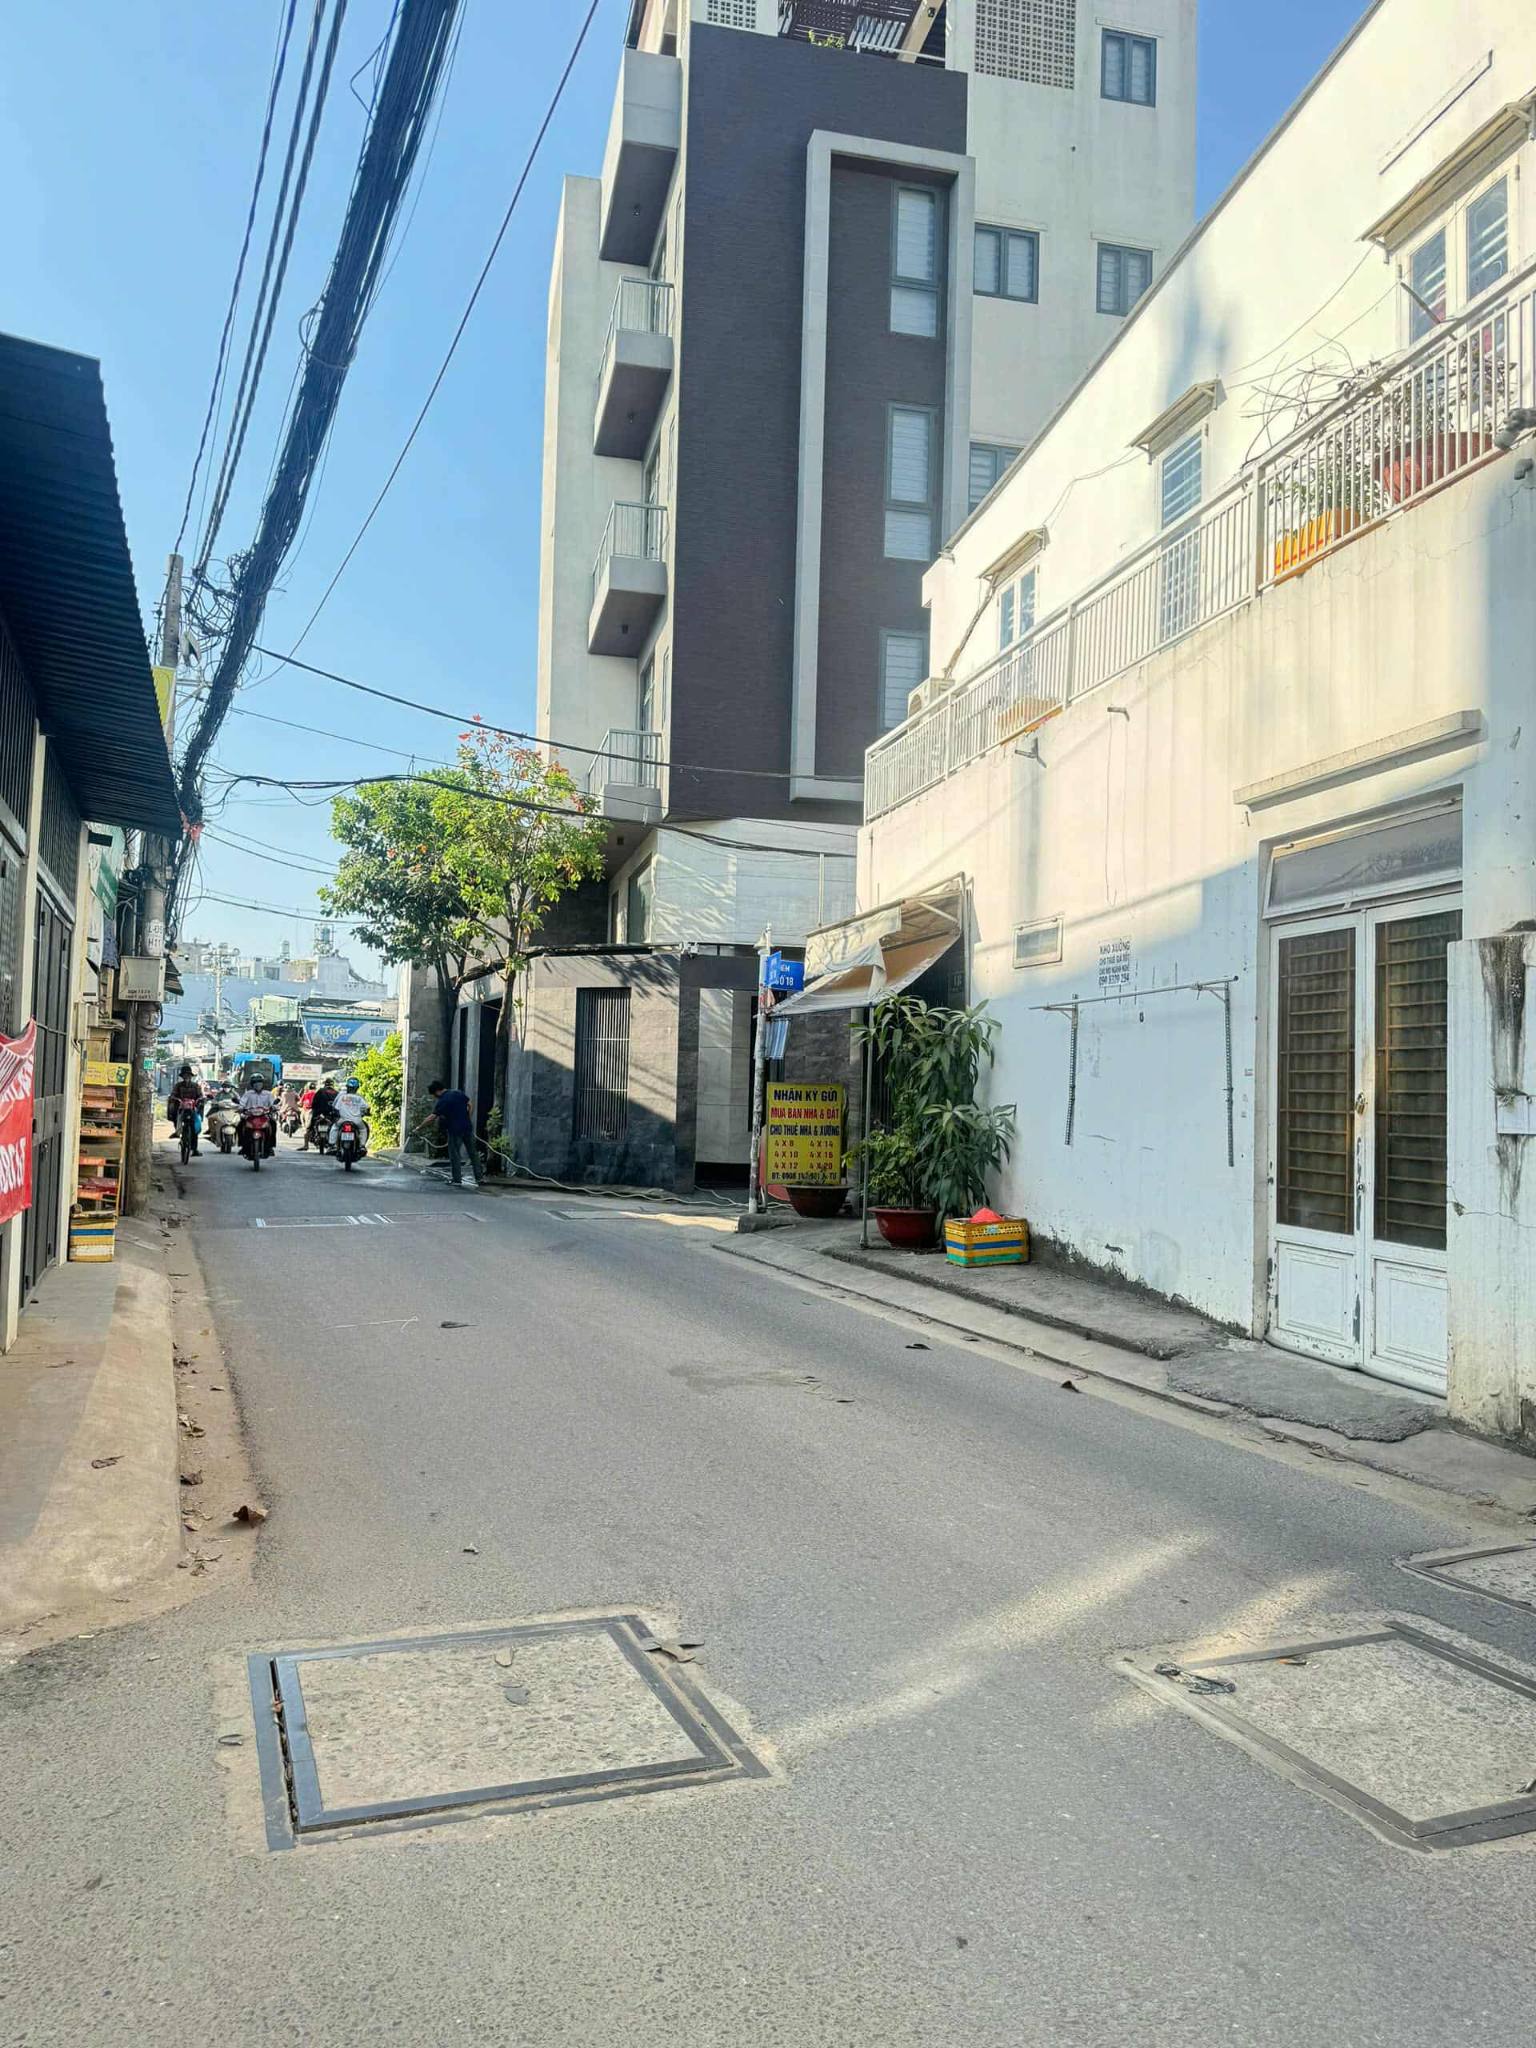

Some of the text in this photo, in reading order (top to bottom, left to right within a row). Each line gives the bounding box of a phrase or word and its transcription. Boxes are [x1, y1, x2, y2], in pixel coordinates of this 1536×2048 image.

[323, 1025, 351, 1039] Tiger
[774, 1088, 802, 1103] NHẬN
[770, 1107, 786, 1119] MUA
[770, 1125, 782, 1135] CHO
